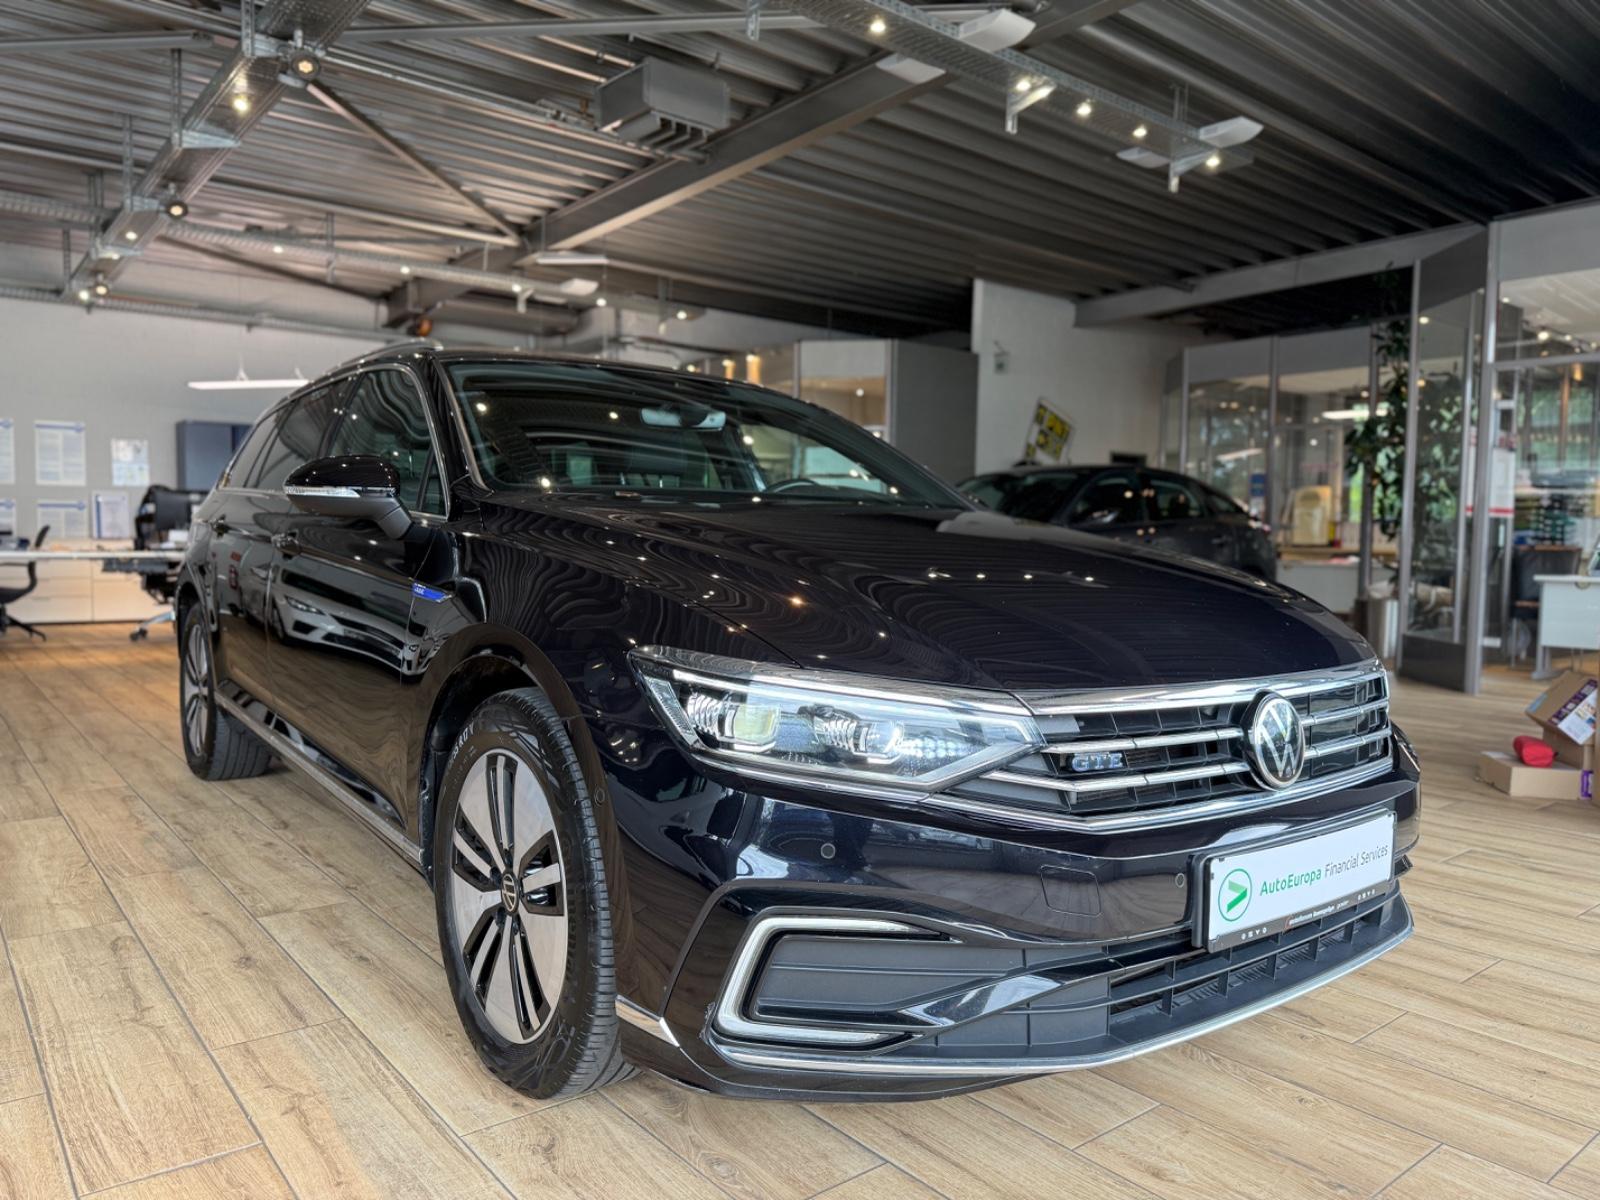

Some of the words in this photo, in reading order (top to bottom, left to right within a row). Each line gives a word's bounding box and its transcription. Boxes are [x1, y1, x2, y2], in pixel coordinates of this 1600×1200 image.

[1072, 751, 1123, 772] GTE
[1259, 868, 1322, 897] AutoEuropa
[1324, 852, 1360, 878] Financial
[1360, 844, 1389, 866] Services
